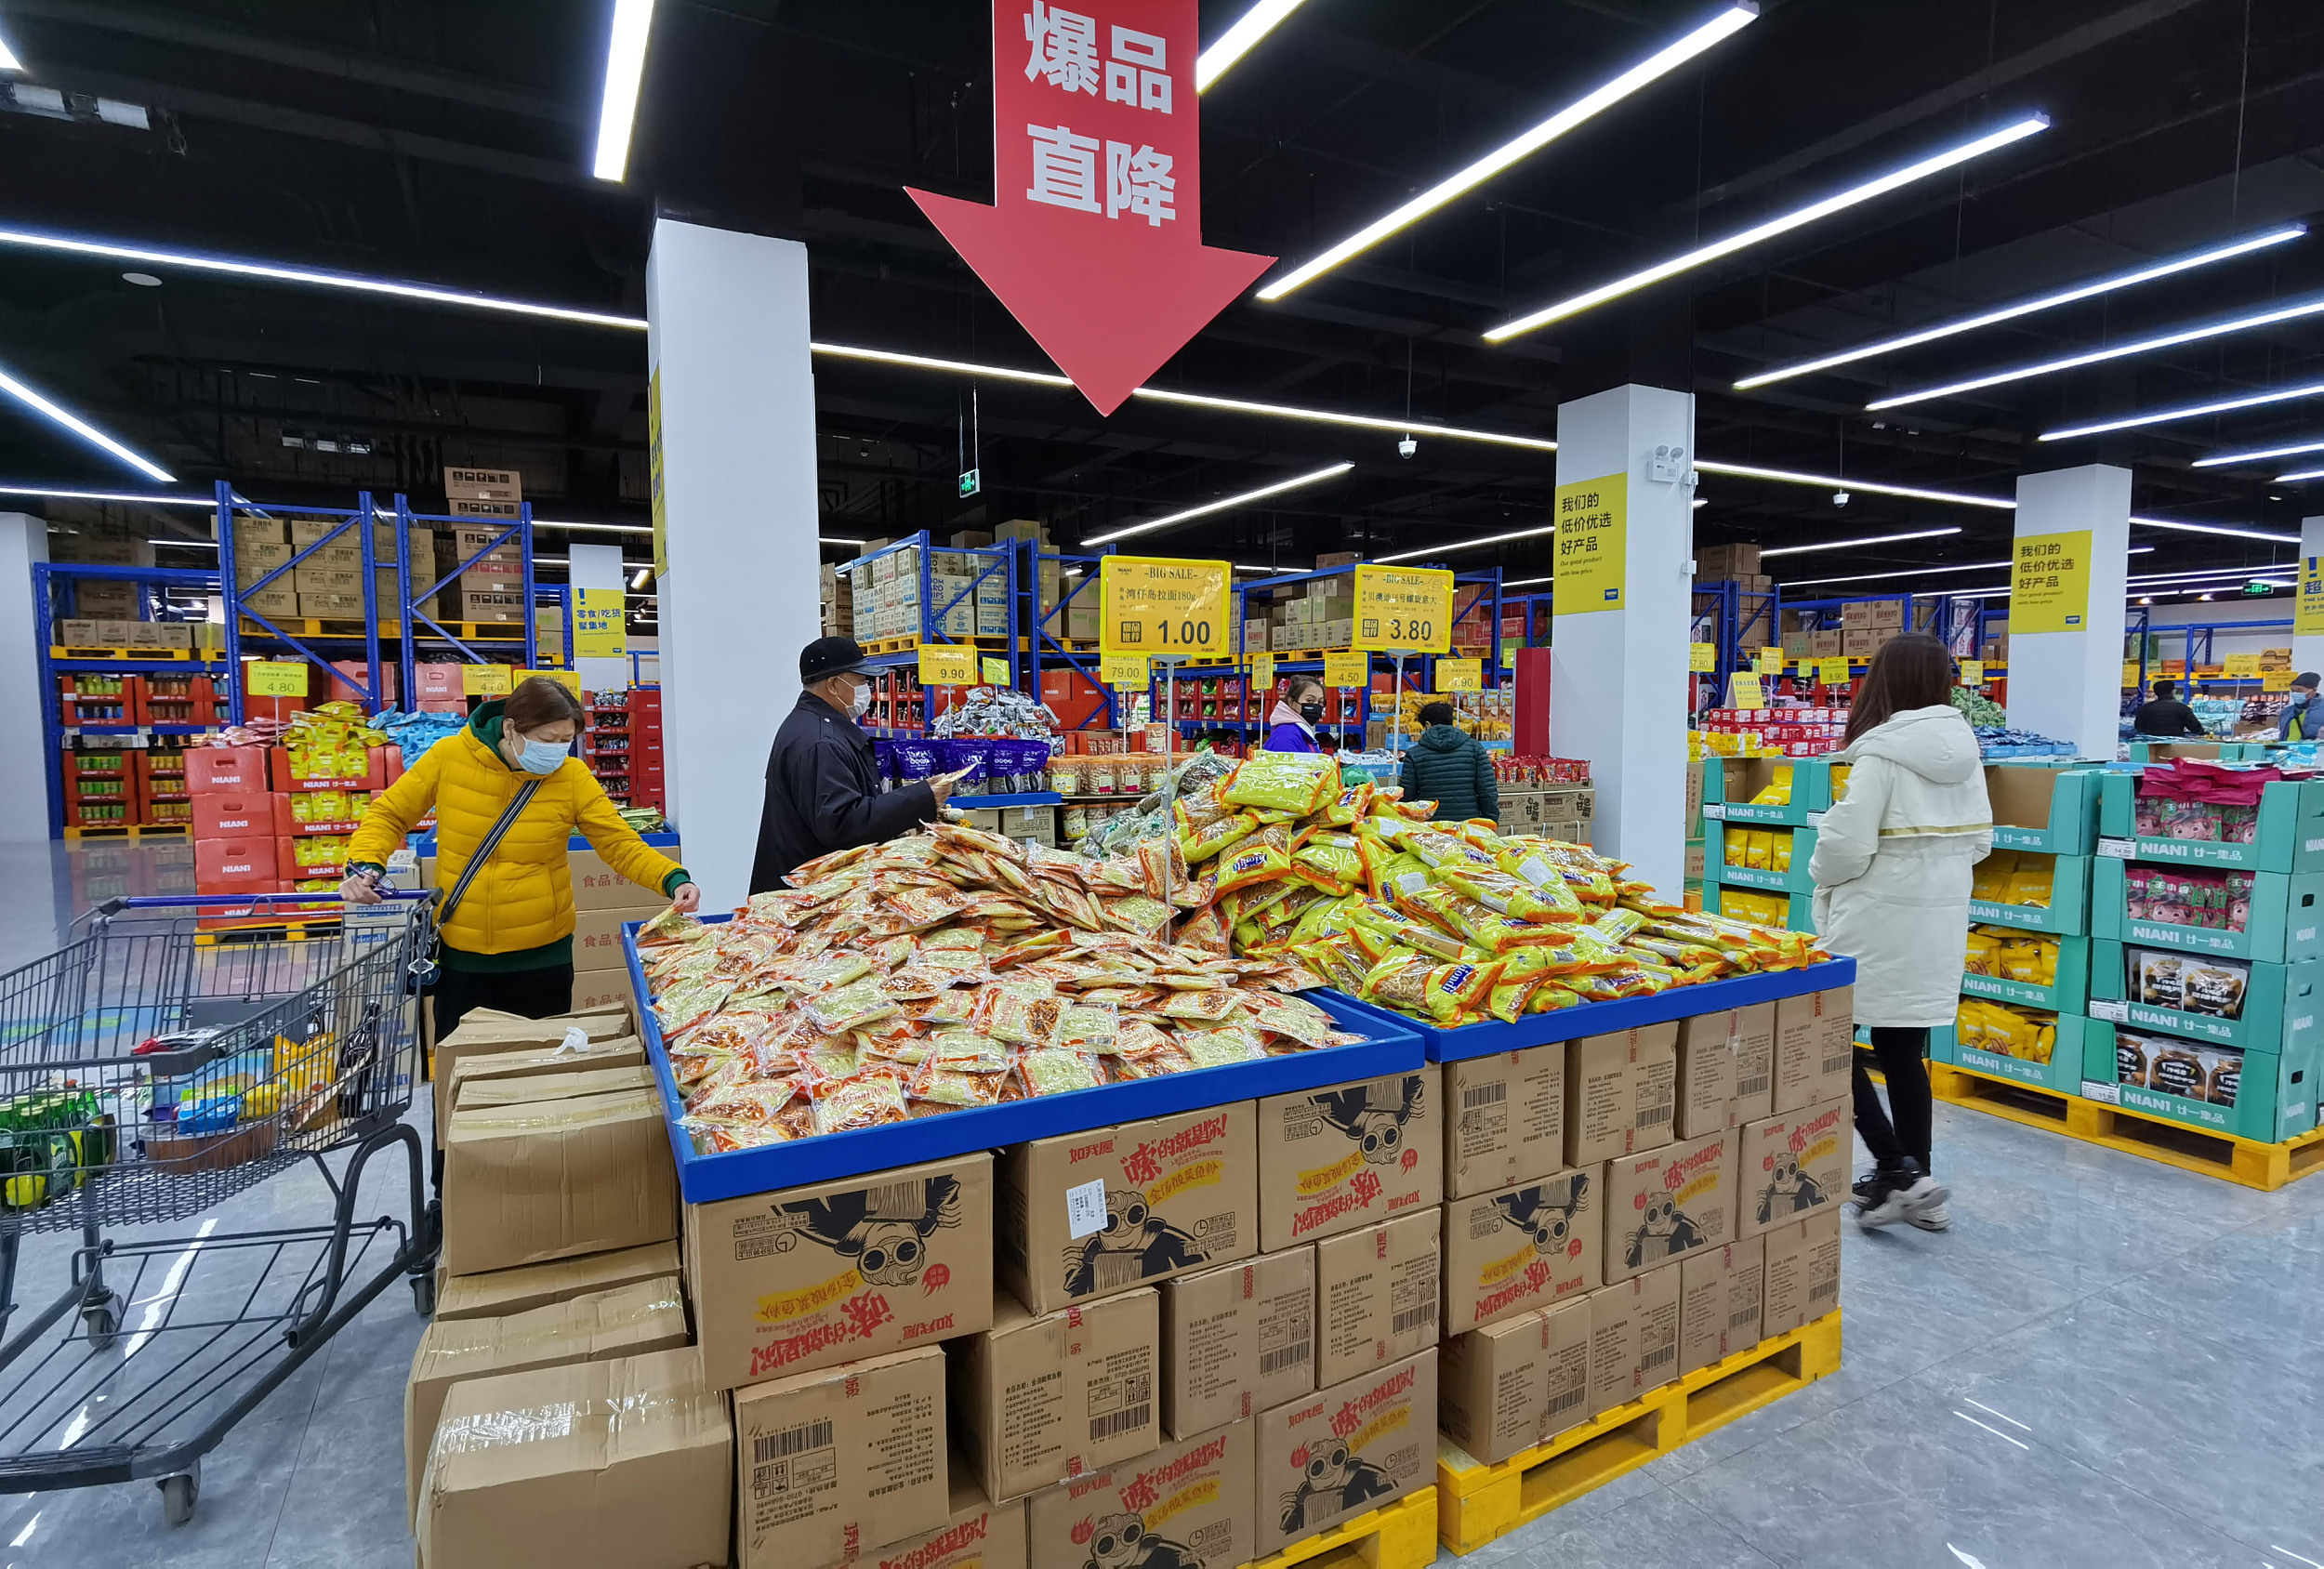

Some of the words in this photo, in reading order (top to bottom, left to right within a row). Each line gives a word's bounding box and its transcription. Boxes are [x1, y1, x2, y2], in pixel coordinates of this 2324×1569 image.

[1023, 1, 1172, 114] 爆品
[1026, 124, 1176, 227] 直降
[1562, 493, 1599, 513] 我们的
[1562, 512, 1612, 534] 低价优选
[1561, 536, 1598, 556] 好产品
[2021, 543, 2061, 558] 我们的
[2020, 559, 2074, 574] 低价优选
[2019, 575, 2059, 589] 好产品
[1127, 588, 1195, 601] 湾仔岛拉面180g
[1158, 620, 1210, 644] 1.00
[1391, 619, 1432, 640] 3.80
[940, 668, 964, 679] 9.90
[1111, 667, 1140, 679] 79.00
[1339, 673, 1359, 682] 4.50
[267, 683, 295, 692] 4.80
